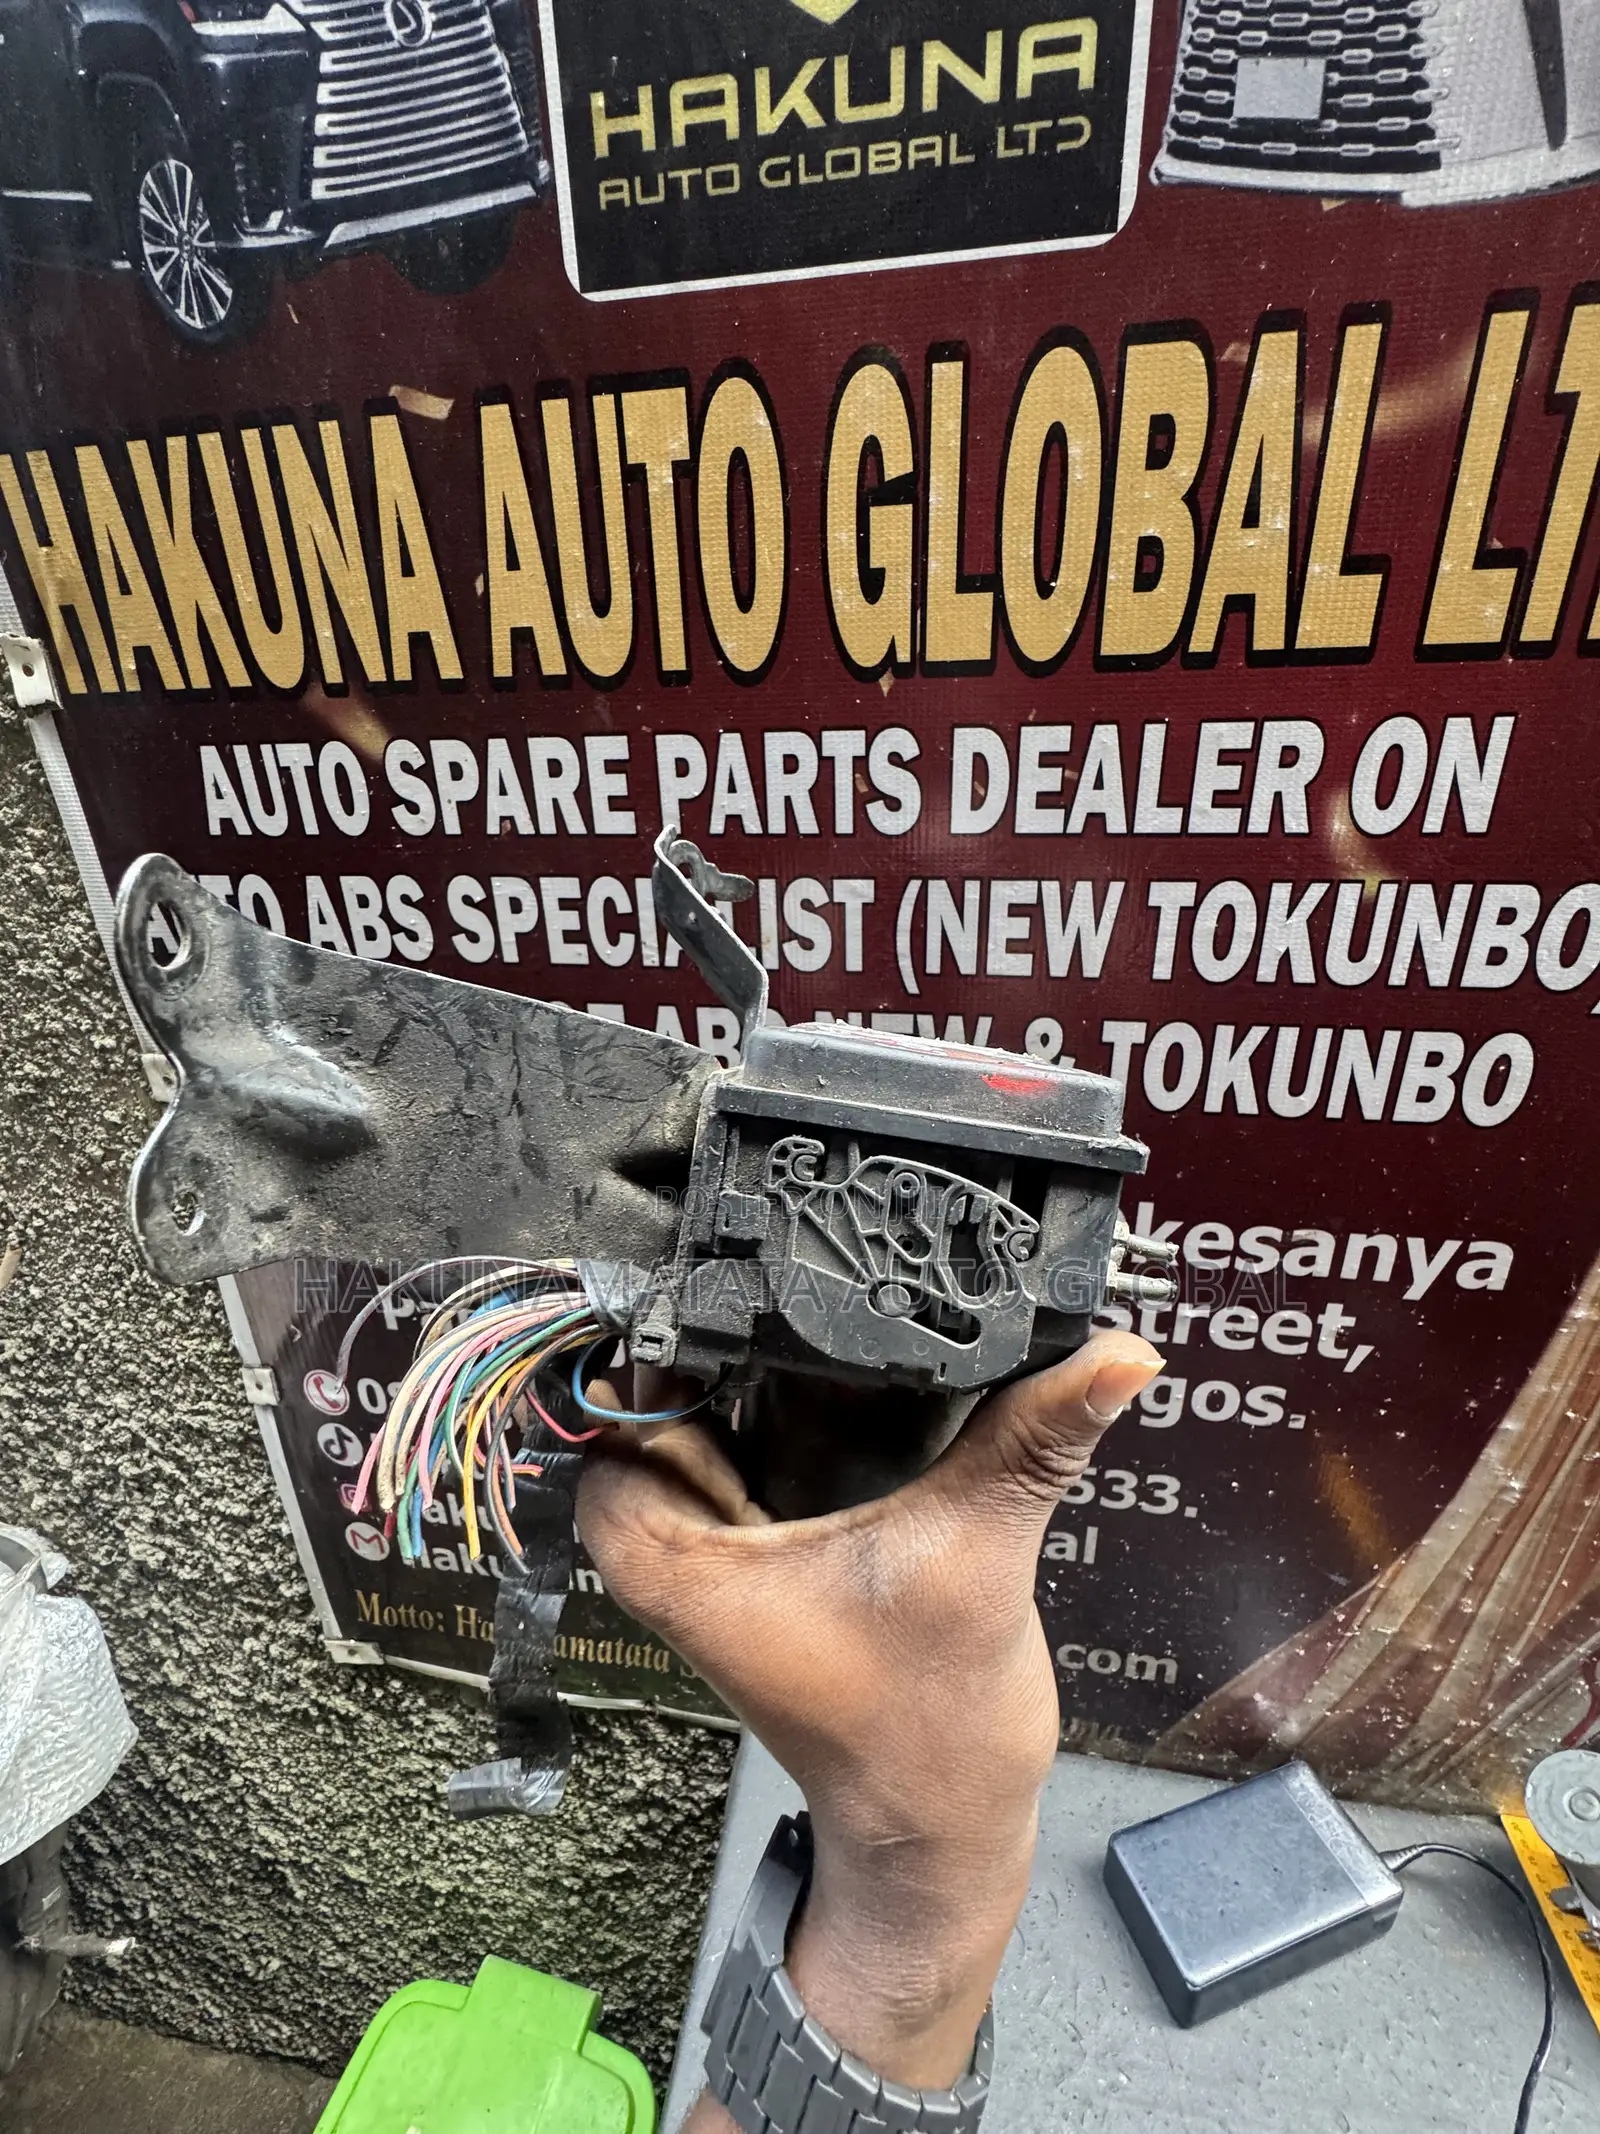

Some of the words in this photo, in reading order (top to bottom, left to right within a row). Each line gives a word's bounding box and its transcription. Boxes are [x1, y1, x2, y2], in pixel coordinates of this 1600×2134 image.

[589, 17, 1098, 160] HAKUNA
[598, 164, 741, 211] AUTO
[758, 135, 976, 188] GLOBAL
[0, 413, 464, 696] HAKUNA
[478, 377, 786, 678] AUTO
[826, 323, 1384, 668] GLOBAL
[1422, 304, 1600, 646] LT
[200, 740, 370, 838] AUTO
[384, 735, 638, 836] SPARE
[655, 726, 922, 836] PARTS
[949, 718, 1325, 835] DEALER
[1351, 716, 1515, 836] ON
[305, 874, 434, 963] ABS
[896, 879, 1126, 994] (NEW
[1147, 880, 1600, 1015] TOKUNBO
[1102, 1020, 1535, 1128] TOKUNBO
[1117, 1201, 1514, 1301] kesanya
[1125, 1374, 1307, 1430] gos.
[355, 1589, 445, 1633] Motto:
